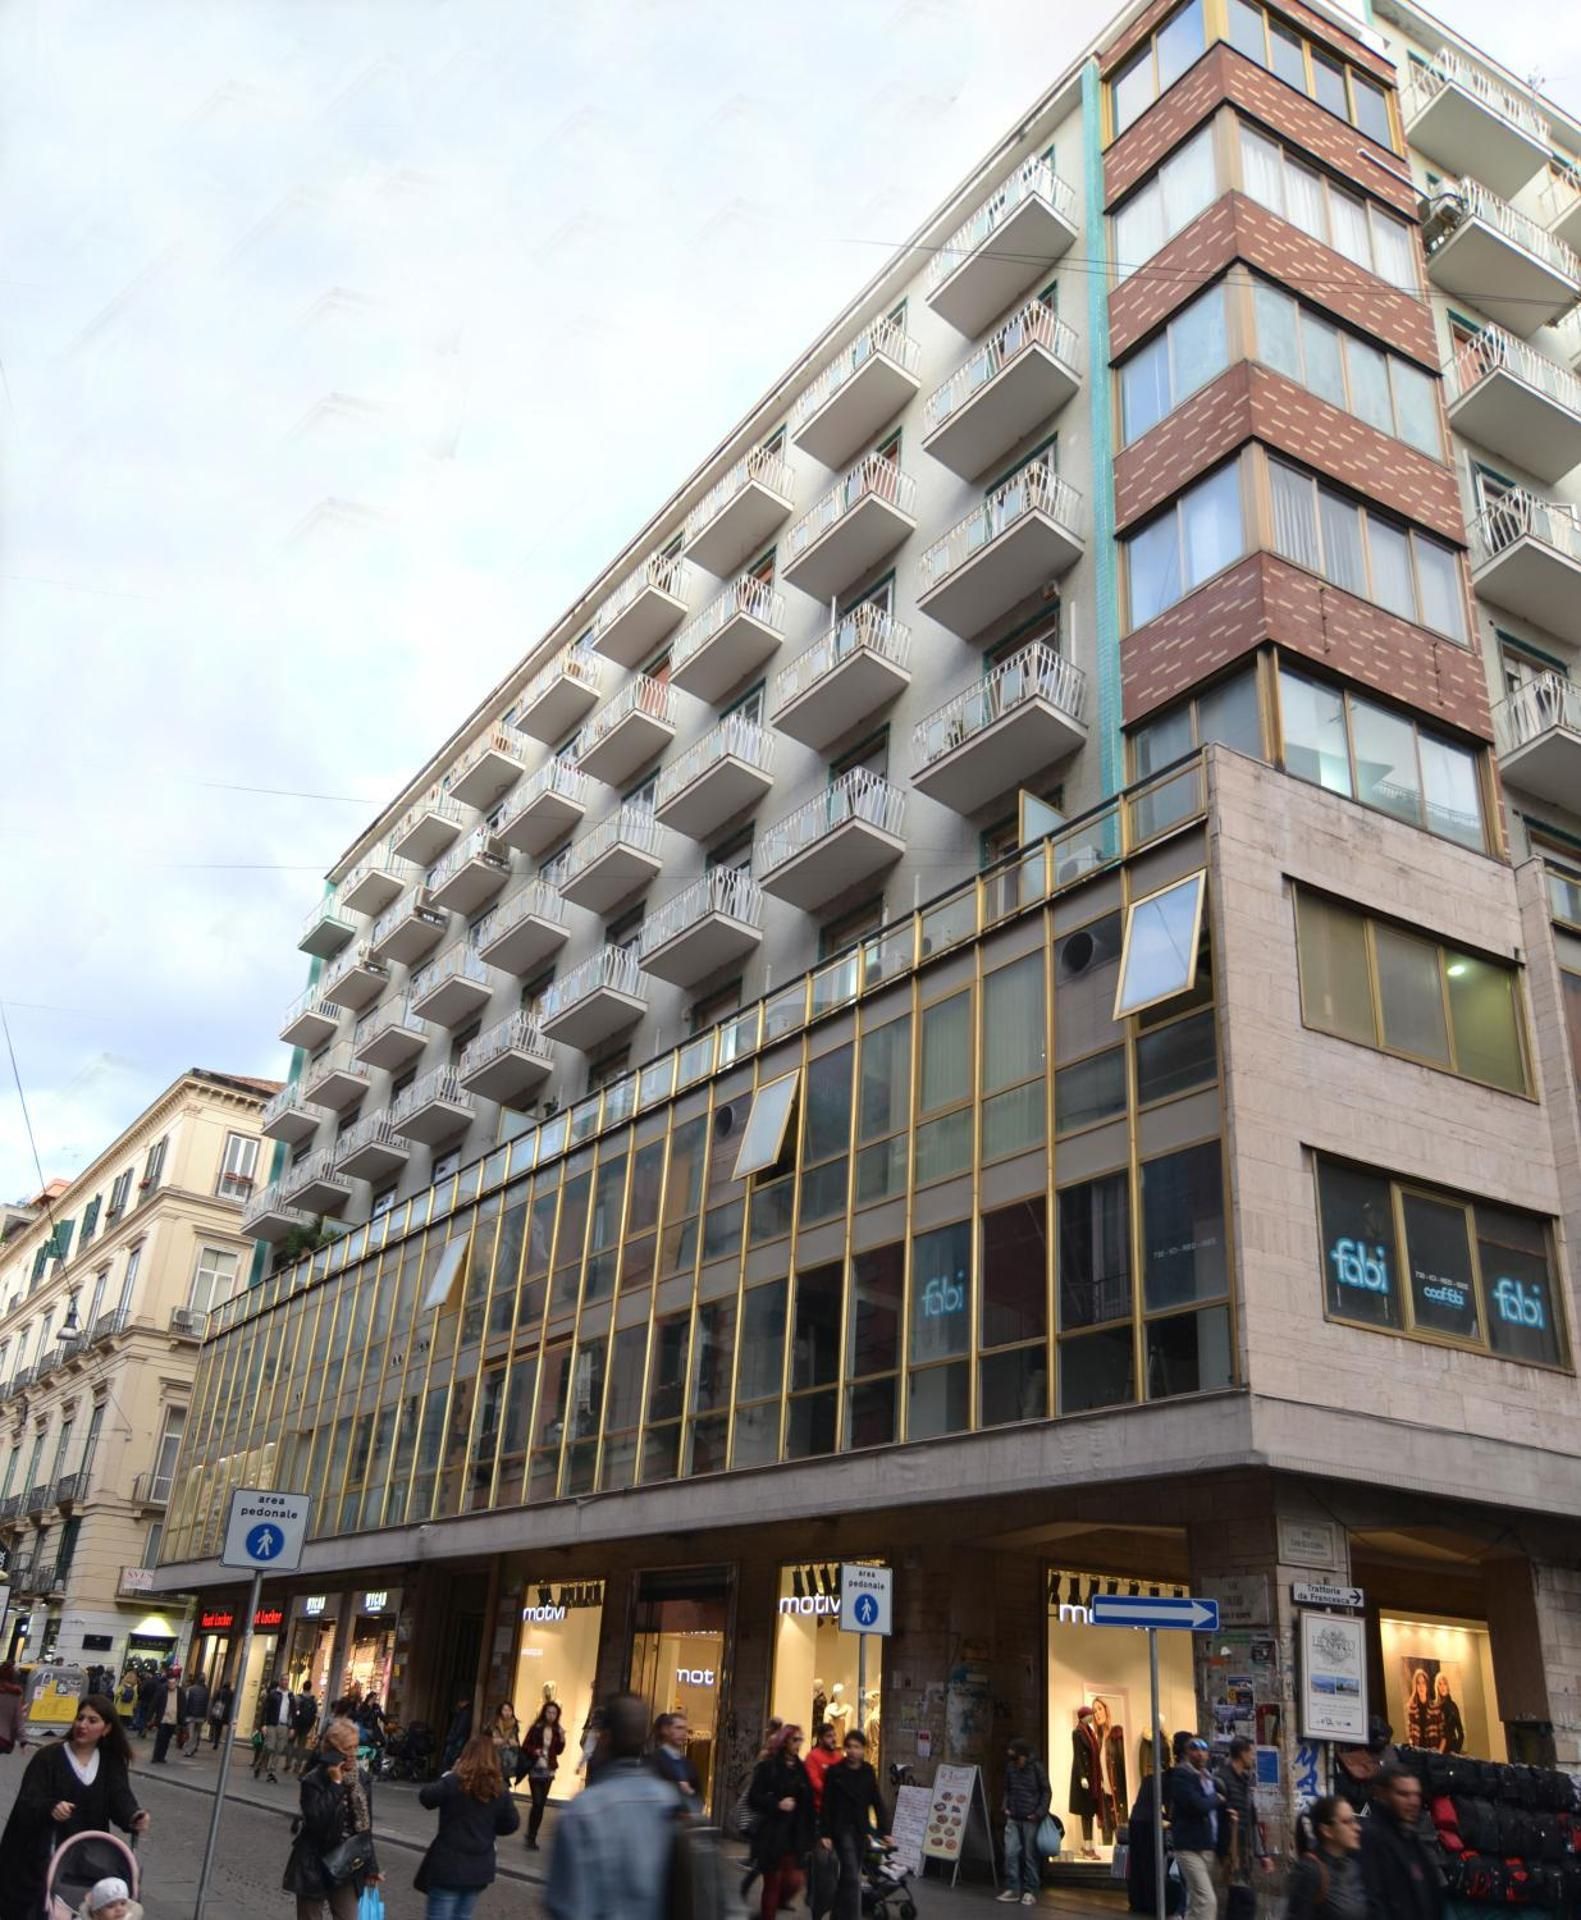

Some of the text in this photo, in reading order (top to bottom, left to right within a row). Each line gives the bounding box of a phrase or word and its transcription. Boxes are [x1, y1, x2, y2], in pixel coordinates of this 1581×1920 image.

[1329, 1238, 1388, 1293] fabi
[921, 1270, 964, 1316] fabi
[1493, 1278, 1546, 1329] fabi
[258, 1496, 285, 1505] area
[240, 1507, 298, 1519] pedonale
[858, 1570, 876, 1578] area
[848, 1580, 885, 1590] pedonale
[1308, 1584, 1341, 1595] Trattoria
[522, 1600, 566, 1621] motivi
[779, 1592, 840, 1614] motiv
